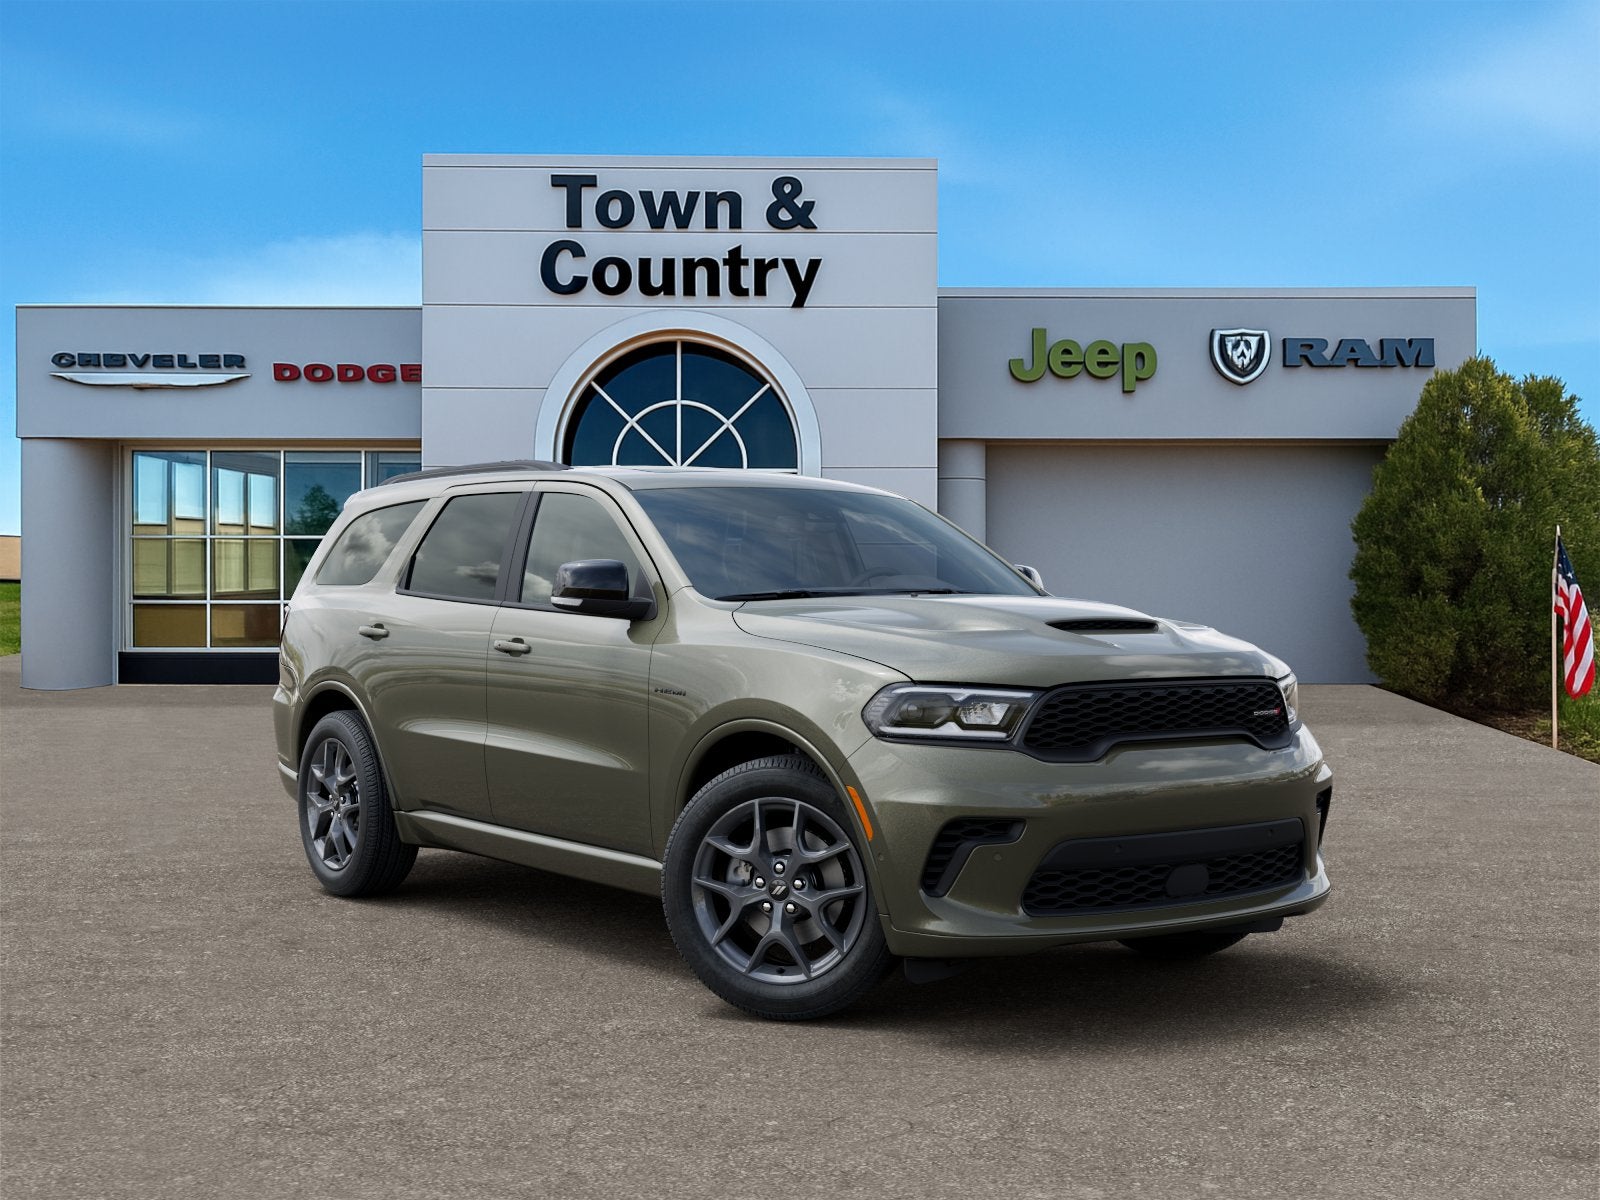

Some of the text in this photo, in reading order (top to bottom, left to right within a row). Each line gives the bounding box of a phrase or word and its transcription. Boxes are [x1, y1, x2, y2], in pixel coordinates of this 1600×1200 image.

[550, 174, 818, 230] Town &
[540, 239, 822, 308] Country
[273, 362, 422, 382] DODGE
[1009, 328, 1157, 393] Jeep
[1283, 337, 1436, 367] RAM
